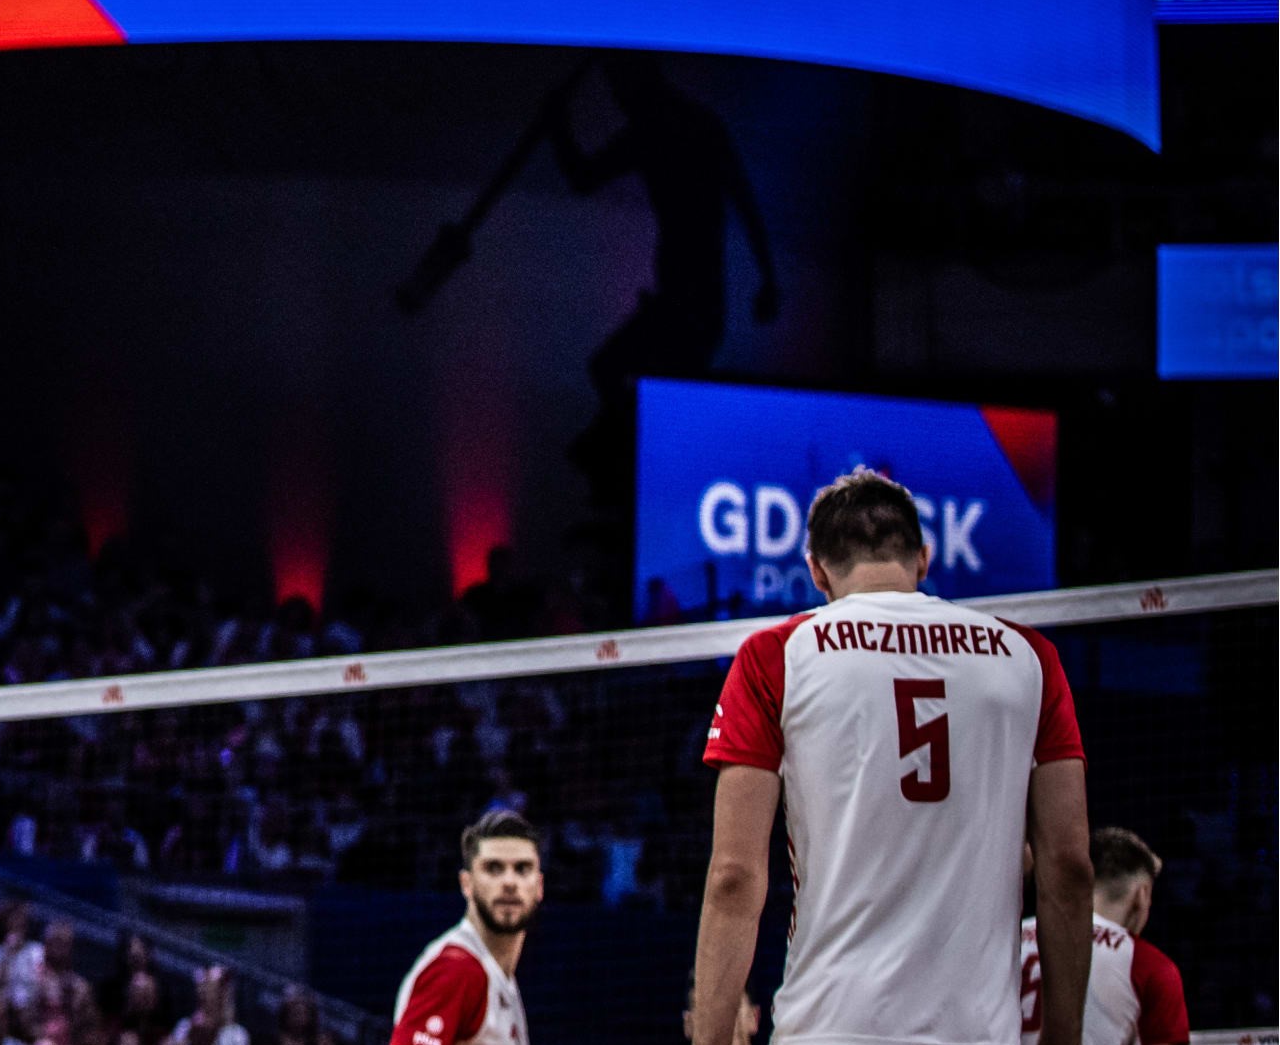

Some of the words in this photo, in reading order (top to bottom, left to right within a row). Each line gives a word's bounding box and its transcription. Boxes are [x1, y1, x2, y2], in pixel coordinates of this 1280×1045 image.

[698, 480, 987, 572] GDSK
[813, 619, 1013, 658] KACZMAREK
[892, 678, 951, 804] 5
